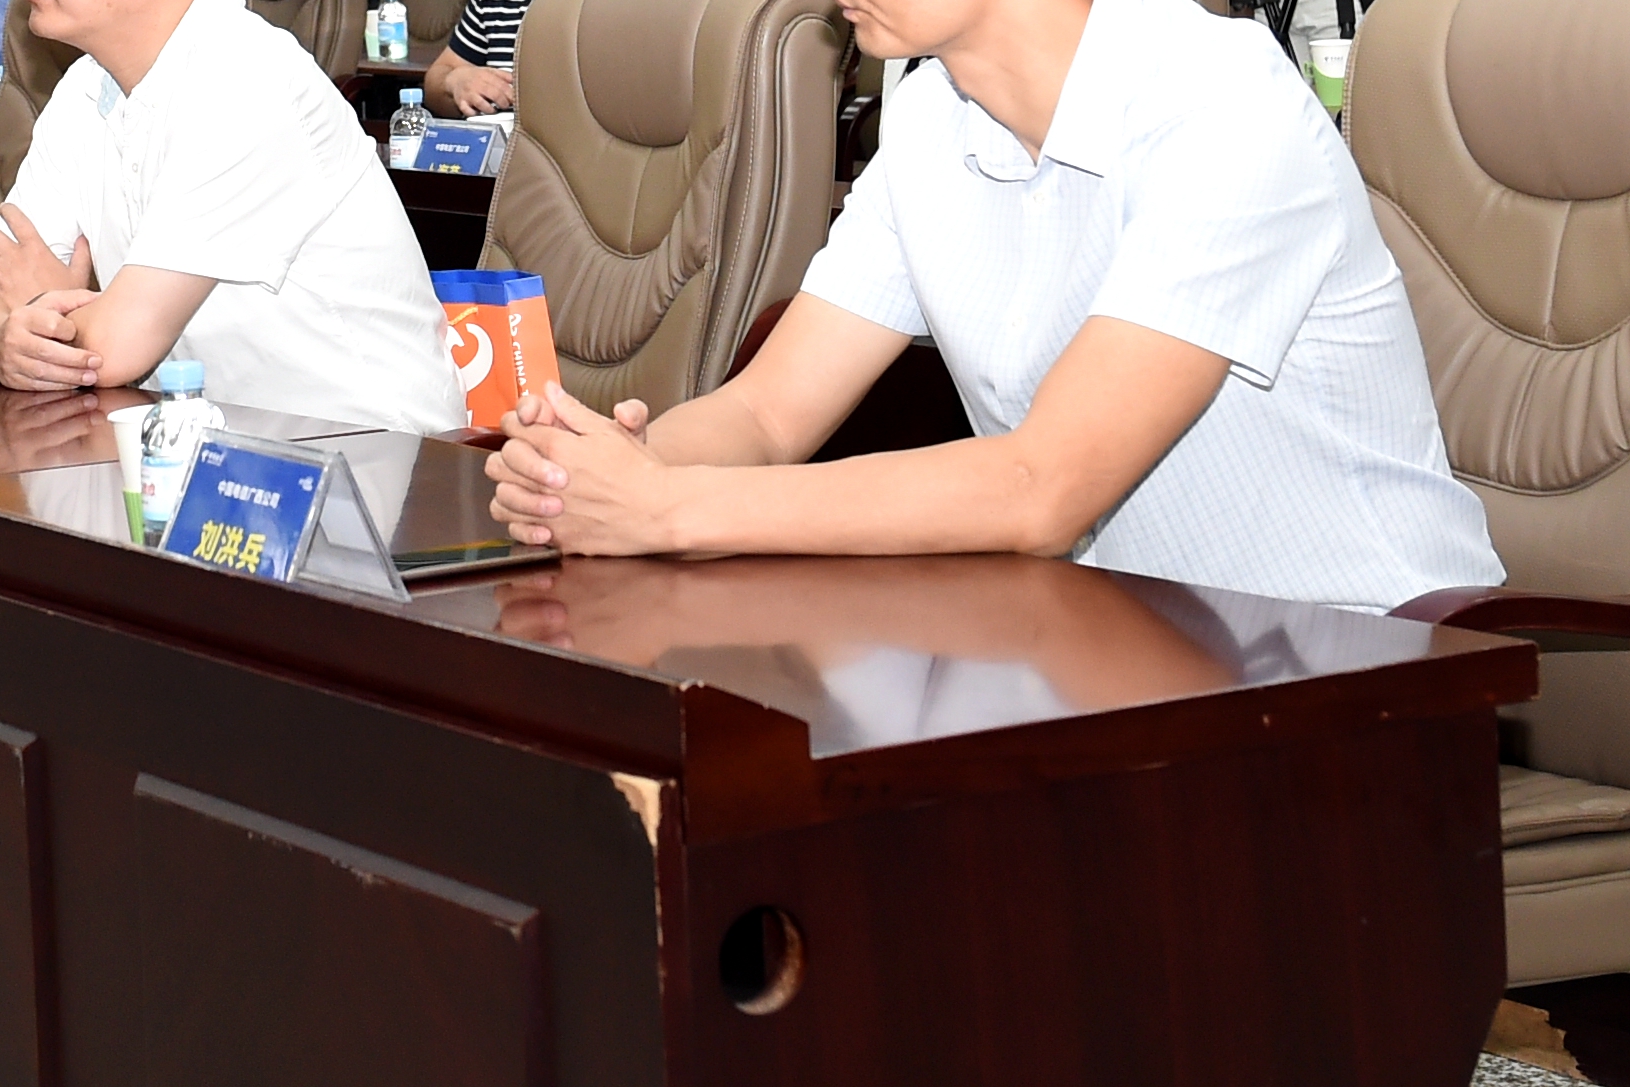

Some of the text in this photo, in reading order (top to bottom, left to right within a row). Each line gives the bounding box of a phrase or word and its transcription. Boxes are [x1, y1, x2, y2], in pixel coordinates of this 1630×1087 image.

[512, 341, 527, 386] CHINA
[192, 518, 267, 574] 刘洪兵
